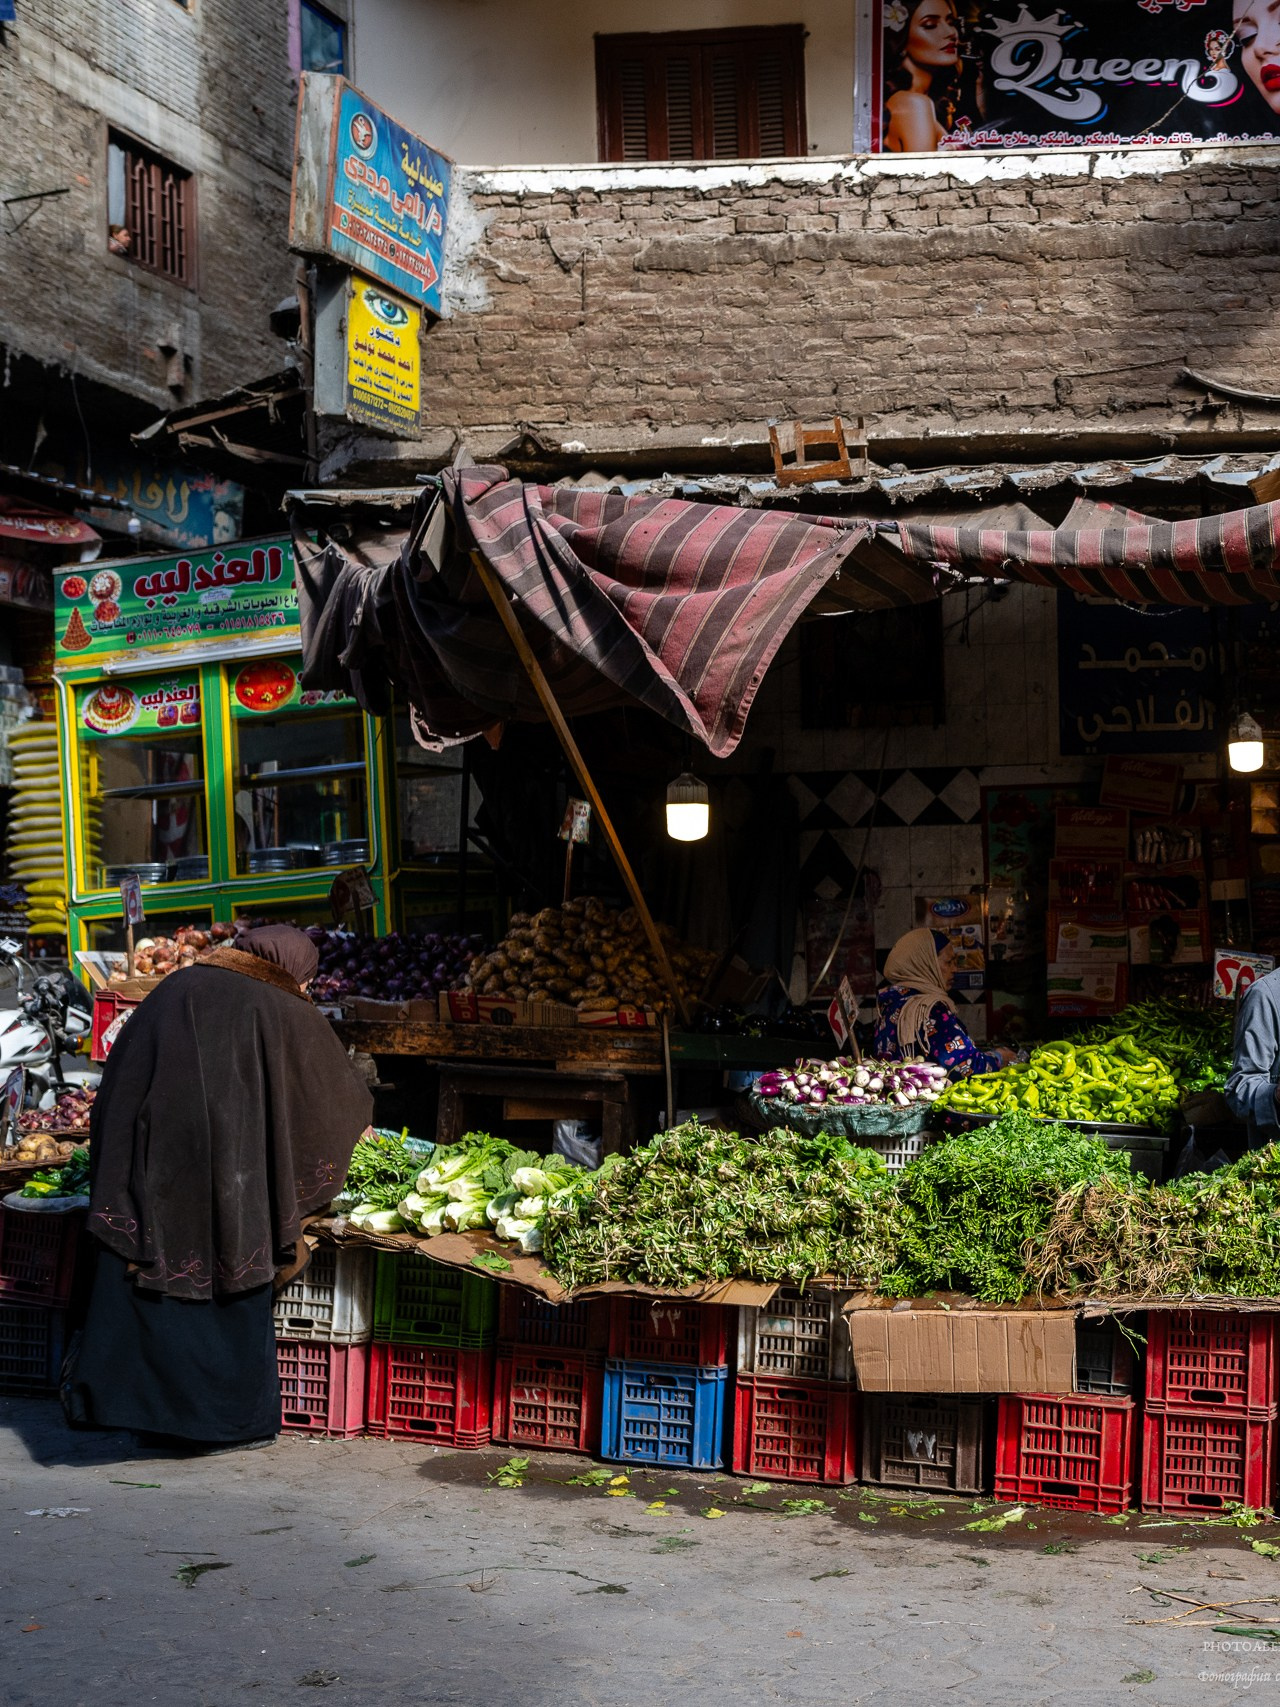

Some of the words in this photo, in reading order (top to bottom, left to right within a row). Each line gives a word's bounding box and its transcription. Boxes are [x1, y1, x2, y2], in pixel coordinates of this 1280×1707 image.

[990, 32, 1238, 120] Queen
[971, 129, 1003, 147] مشاكل
[1004, 130, 1029, 148] علاج
[401, 142, 444, 200] صيدلية
[370, 327, 400, 346] دكتور
[134, 547, 283, 609] العندليب
